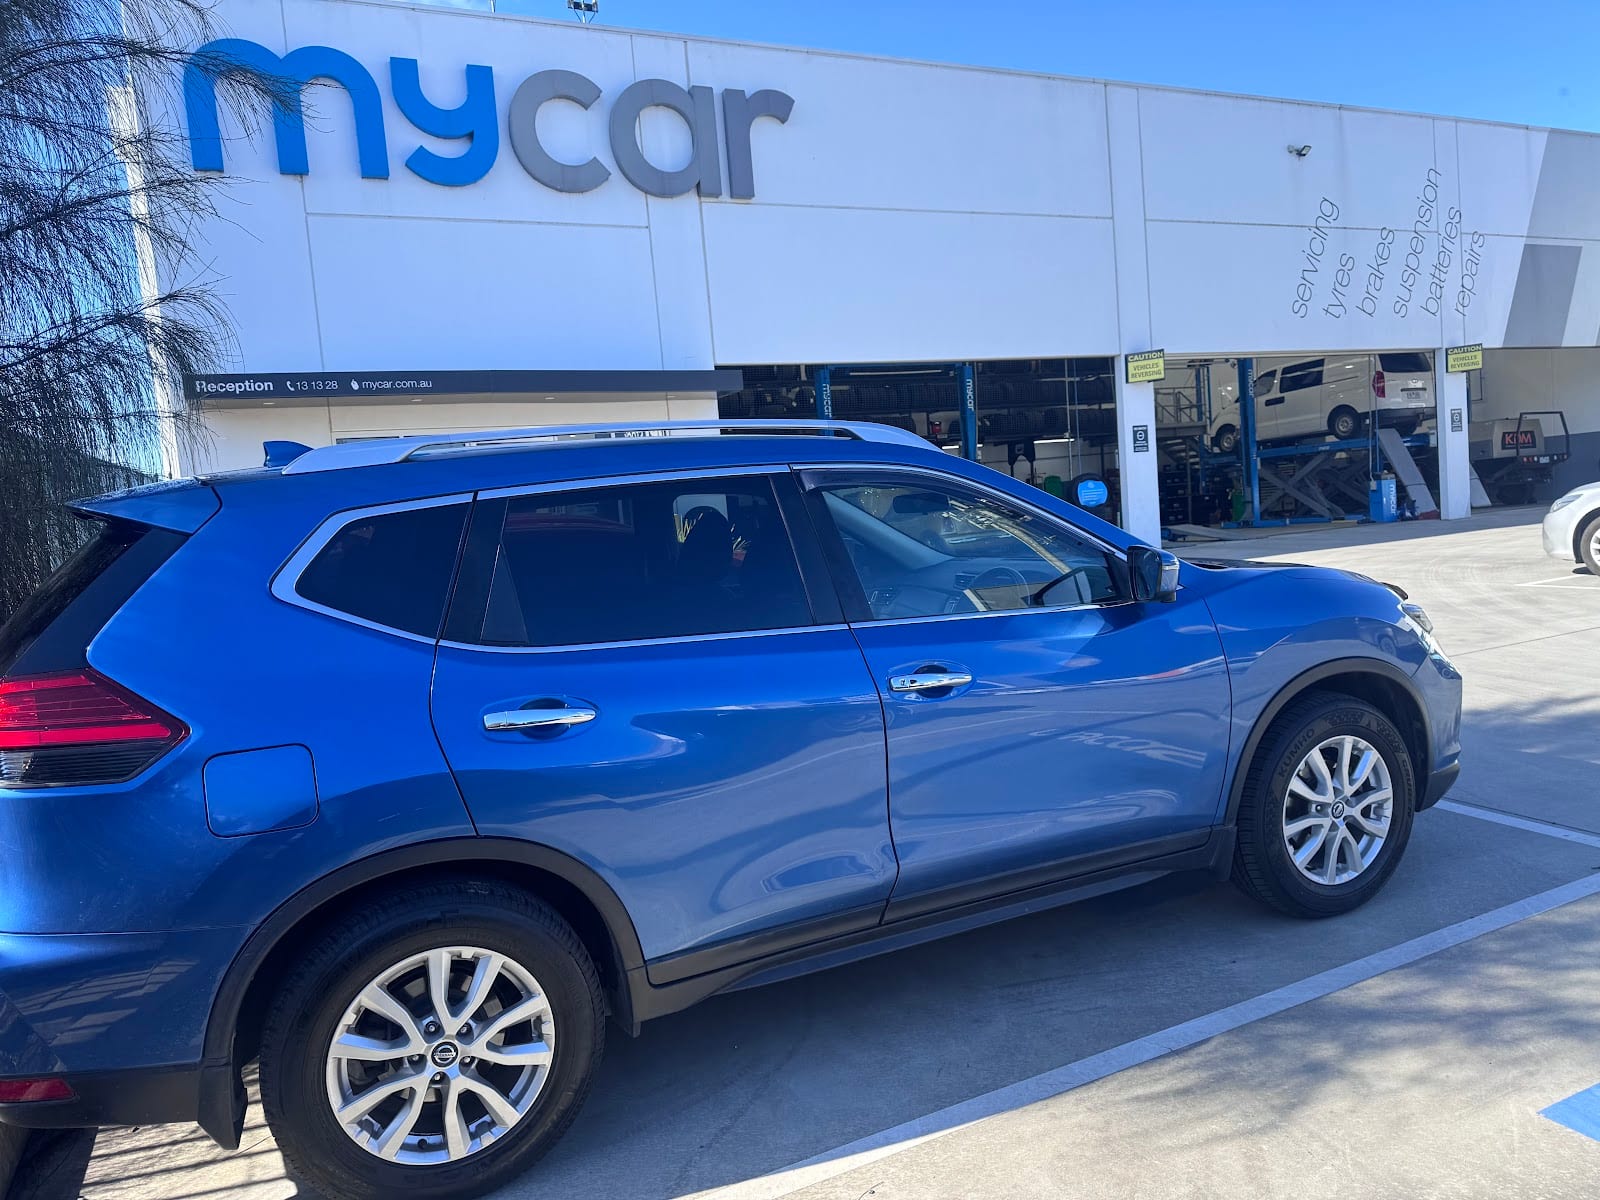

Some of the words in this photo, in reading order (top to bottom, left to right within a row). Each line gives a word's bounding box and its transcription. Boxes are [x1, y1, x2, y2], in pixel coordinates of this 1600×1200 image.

[183, 38, 795, 199] mycar
[1292, 197, 1340, 318] servicing
[1393, 167, 1442, 318] suspension
[1355, 227, 1395, 318] brakes
[1420, 206, 1462, 317] batteries
[1454, 230, 1485, 317] repairs
[1323, 253, 1355, 319] tyres
[1128, 351, 1163, 362] CAUTION
[1132, 362, 1159, 371] VEHICLES
[1448, 346, 1482, 355] CAUTION
[1450, 361, 1480, 369] REVERSING
[1452, 355, 1478, 363] VEHICLES
[196, 379, 274, 394] Reception
[296, 381, 308, 391] 13
[311, 381, 323, 390] 13
[325, 380, 338, 390] 28
[362, 379, 432, 391] mycar.com.au
[1130, 370, 1162, 379] REVERSING
[822, 384, 832, 418] mycar
[966, 379, 974, 411] mycar
[1389, 484, 1397, 515] mycar
[1278, 728, 1316, 777] KUMHO
